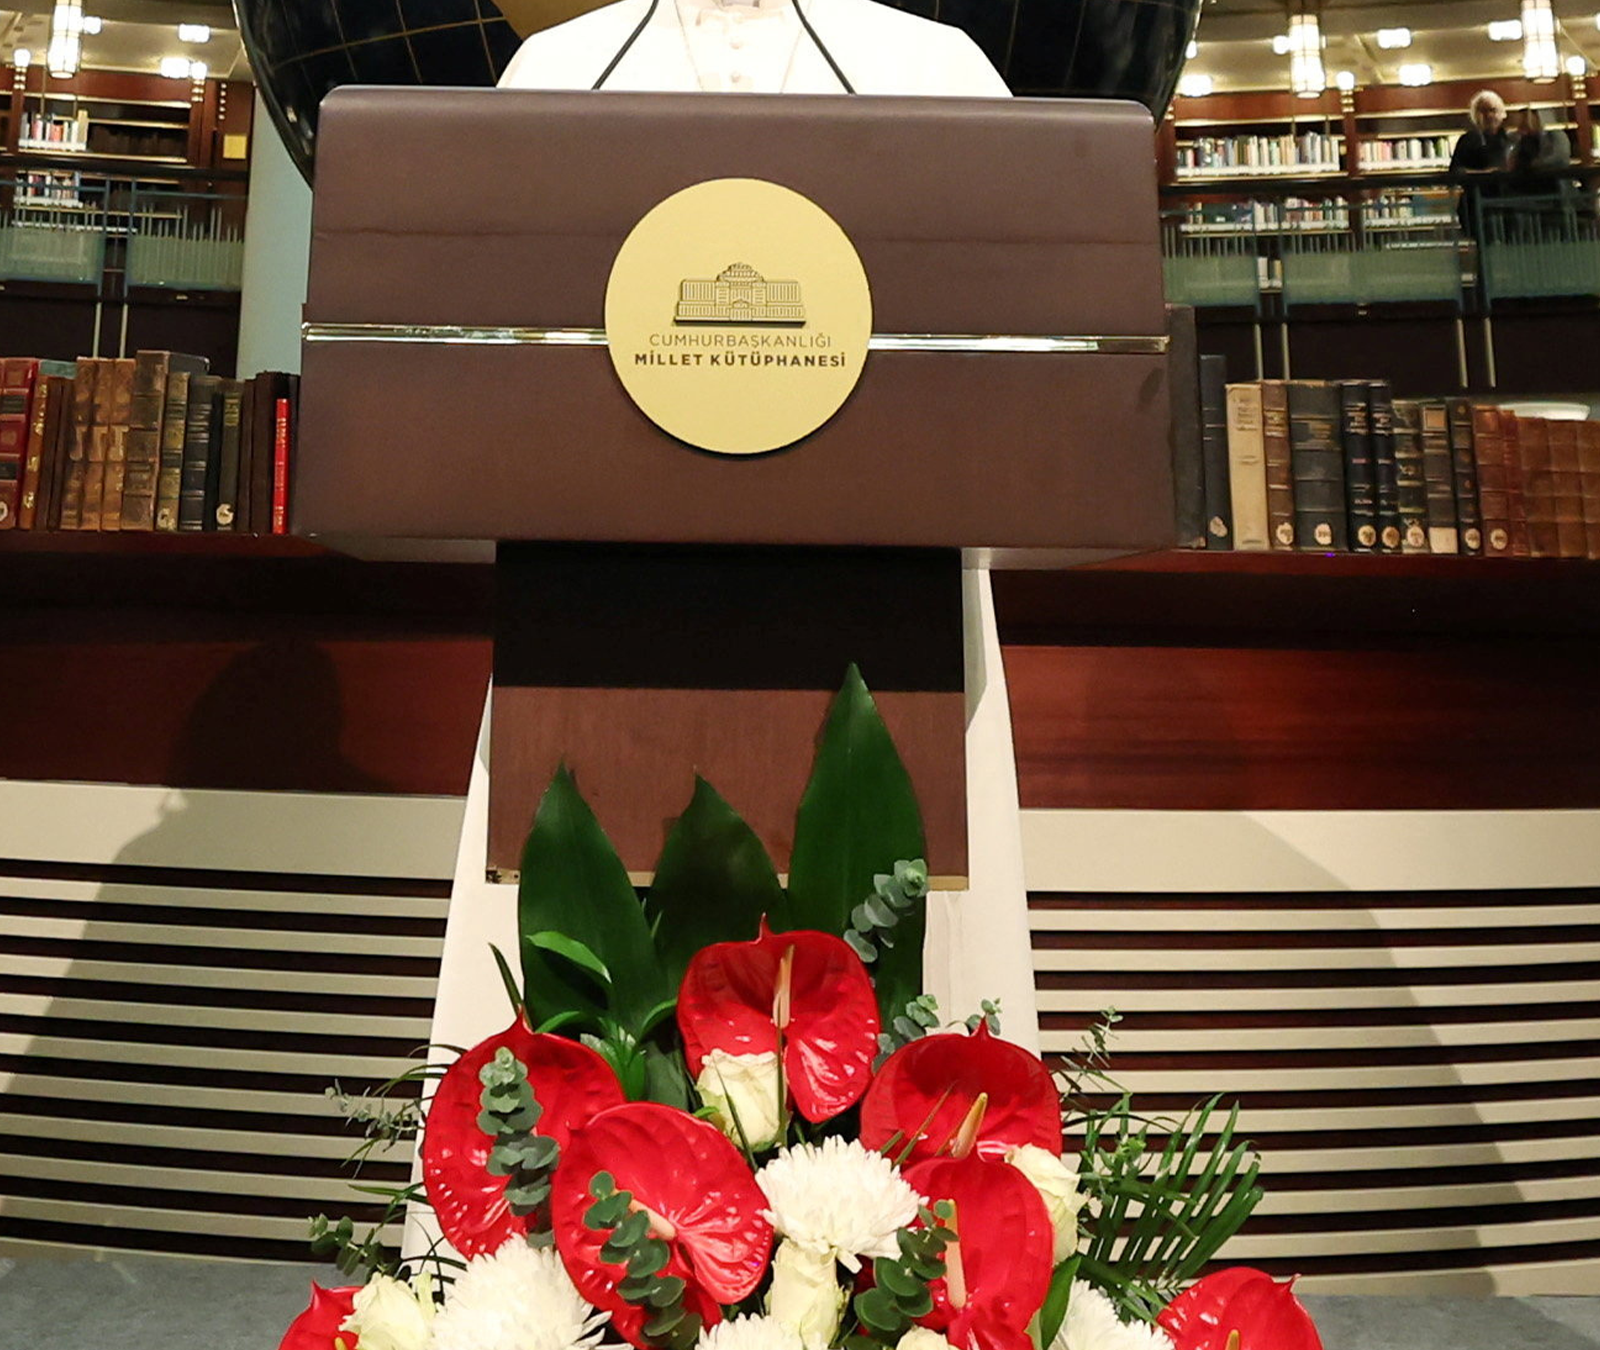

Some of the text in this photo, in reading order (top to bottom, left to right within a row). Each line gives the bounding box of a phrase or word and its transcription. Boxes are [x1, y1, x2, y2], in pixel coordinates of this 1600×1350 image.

[649, 333, 831, 349] CUMHURBAŞKANLIĞI
[634, 350, 846, 367] MİLLET KÜTÜPHANESİ
